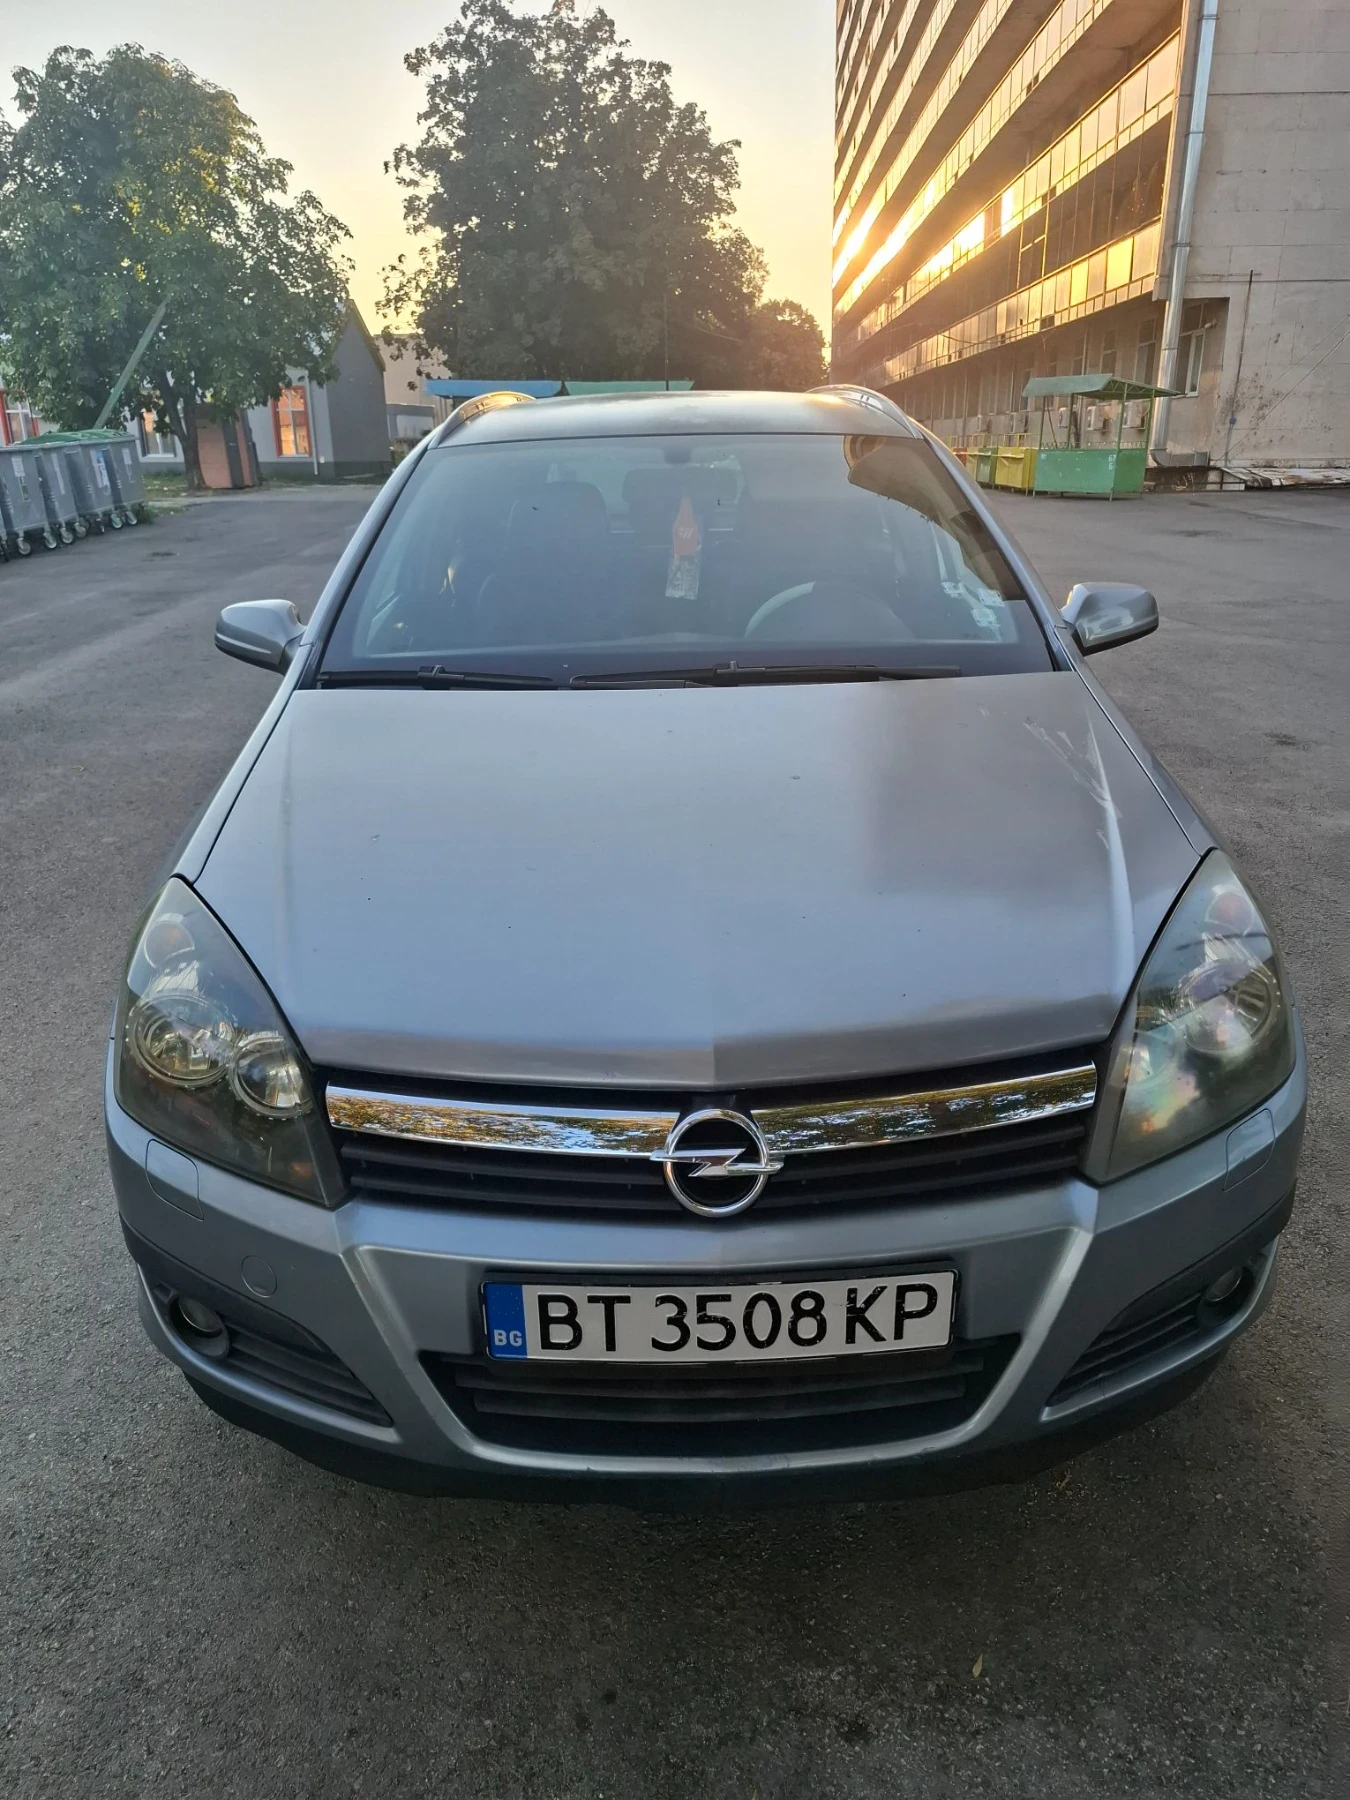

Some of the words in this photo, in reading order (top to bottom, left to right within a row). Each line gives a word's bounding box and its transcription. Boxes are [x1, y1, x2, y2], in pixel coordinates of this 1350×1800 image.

[493, 1329, 523, 1347] BG
[537, 1292, 632, 1352] BT
[651, 1289, 828, 1352] 3508
[845, 1282, 939, 1345] KP
